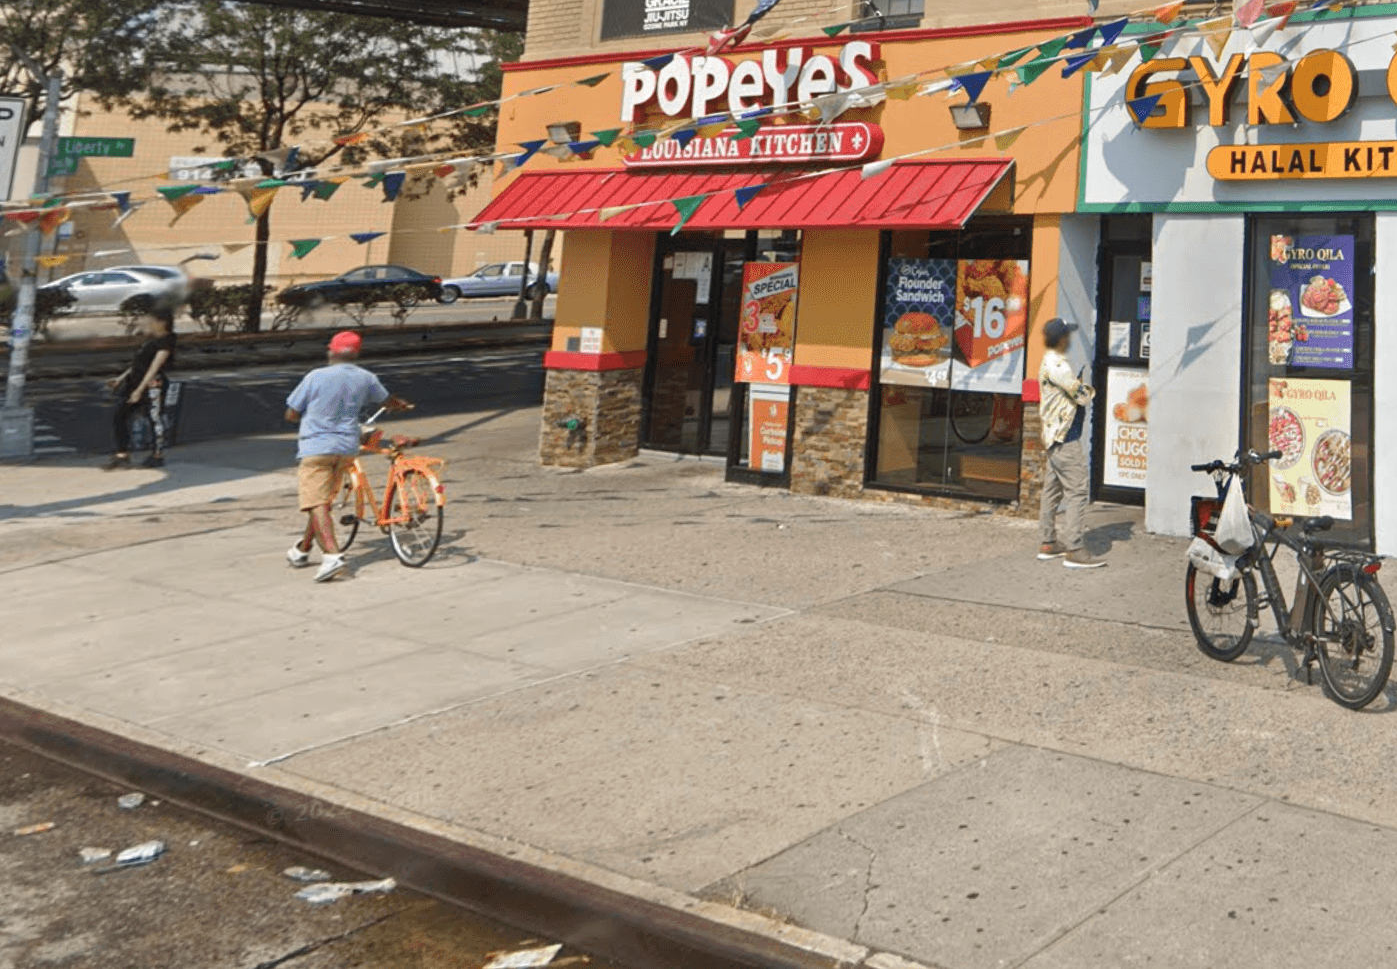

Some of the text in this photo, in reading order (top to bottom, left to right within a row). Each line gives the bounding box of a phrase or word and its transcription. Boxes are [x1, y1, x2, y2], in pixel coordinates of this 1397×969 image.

[644, 9, 690, 23] JIU-JITSU
[1125, 48, 1356, 129] GYRO
[749, 131, 843, 157] KITCHEN
[1230, 148, 1324, 174] HALAL
[1317, 249, 1345, 261] QILA
[753, 278, 797, 296] SPECIAL
[898, 276, 944, 290] Flounder
[896, 290, 945, 303] Sandwich
[1287, 389, 1336, 401] GYRO QILA
